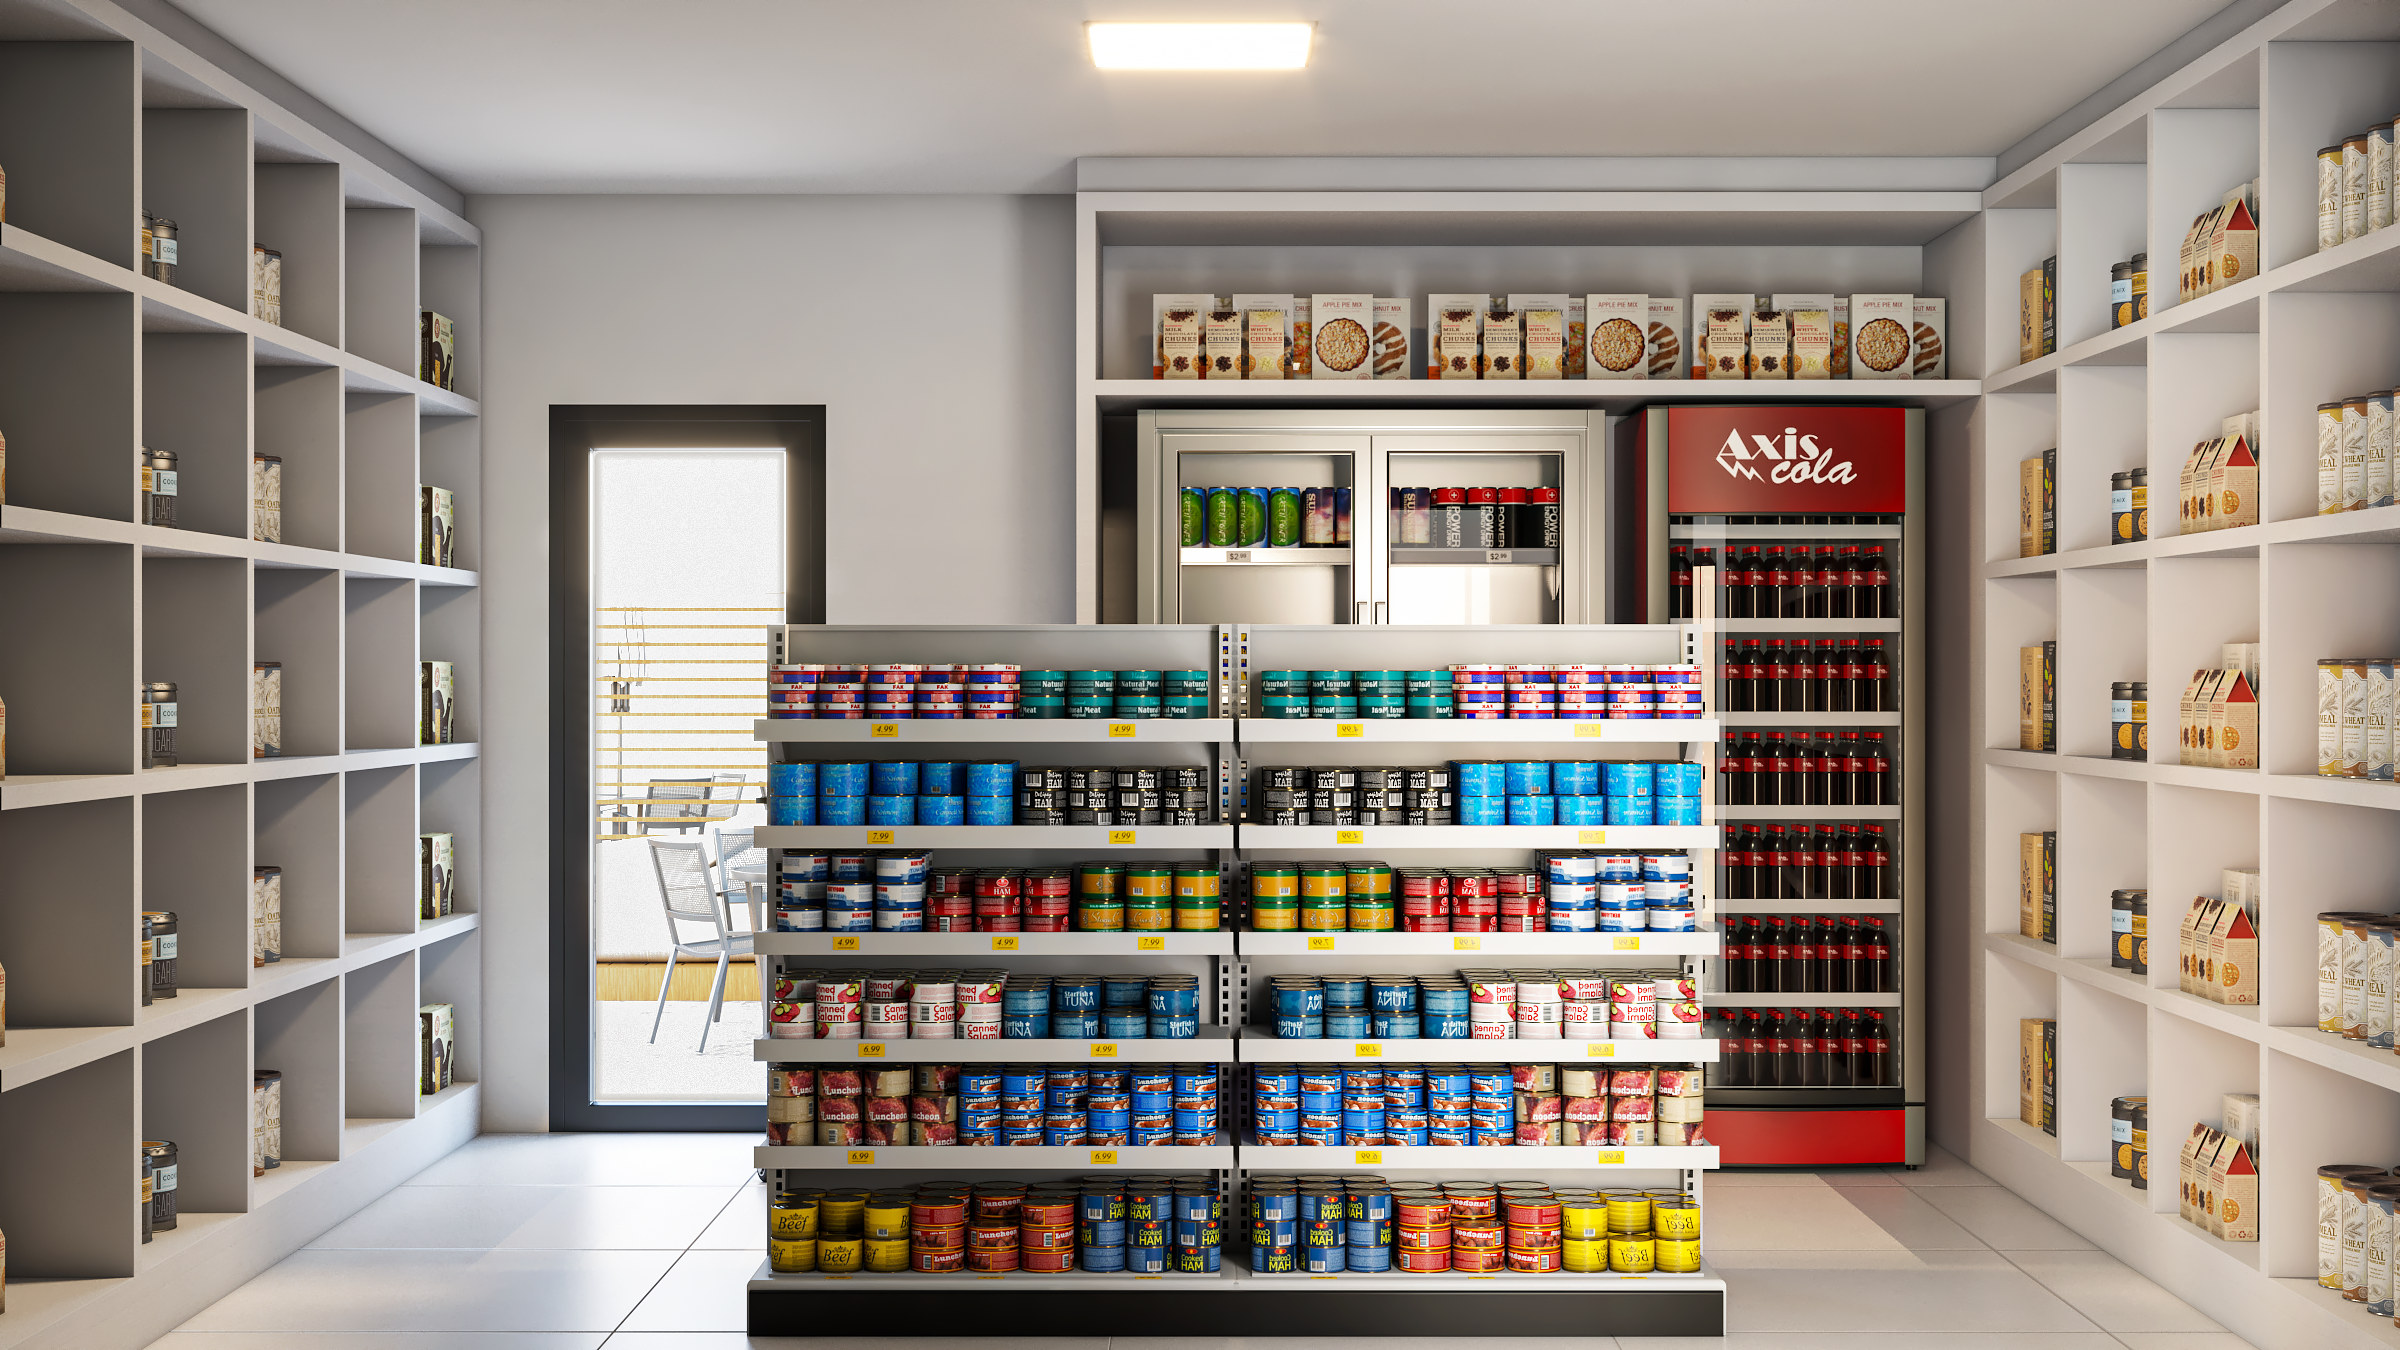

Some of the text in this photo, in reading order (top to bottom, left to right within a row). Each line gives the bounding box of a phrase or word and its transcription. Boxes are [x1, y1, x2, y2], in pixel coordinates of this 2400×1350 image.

[1716, 427, 1819, 461] Axis
[1771, 448, 1858, 484] cola
[1451, 506, 1461, 548] POWER
[1486, 506, 1494, 548] POWER
[1550, 506, 1558, 548] POWER
[1138, 779, 1154, 788] HAM
[1179, 778, 1197, 786] HAM
[1034, 799, 1052, 807] HAM
[1089, 799, 1106, 807] HAM
[1144, 799, 1158, 807] HAM
[1065, 997, 1094, 1006] TUNA
[818, 1004, 845, 1013] Canned
[817, 1013, 845, 1021] Salami
[968, 1024, 998, 1032] Canned
[821, 1111, 859, 1121] Luncheon
[869, 1111, 907, 1120] Luncheon
[982, 1198, 1020, 1207] Luncheon
[1130, 1209, 1151, 1219] HAM
[778, 1216, 809, 1232] Beef
[979, 1229, 1017, 1238] Luncheon
[1139, 1236, 1162, 1245] HAM
[824, 1248, 854, 1265] Beef
[1181, 1261, 1203, 1271] HAM
